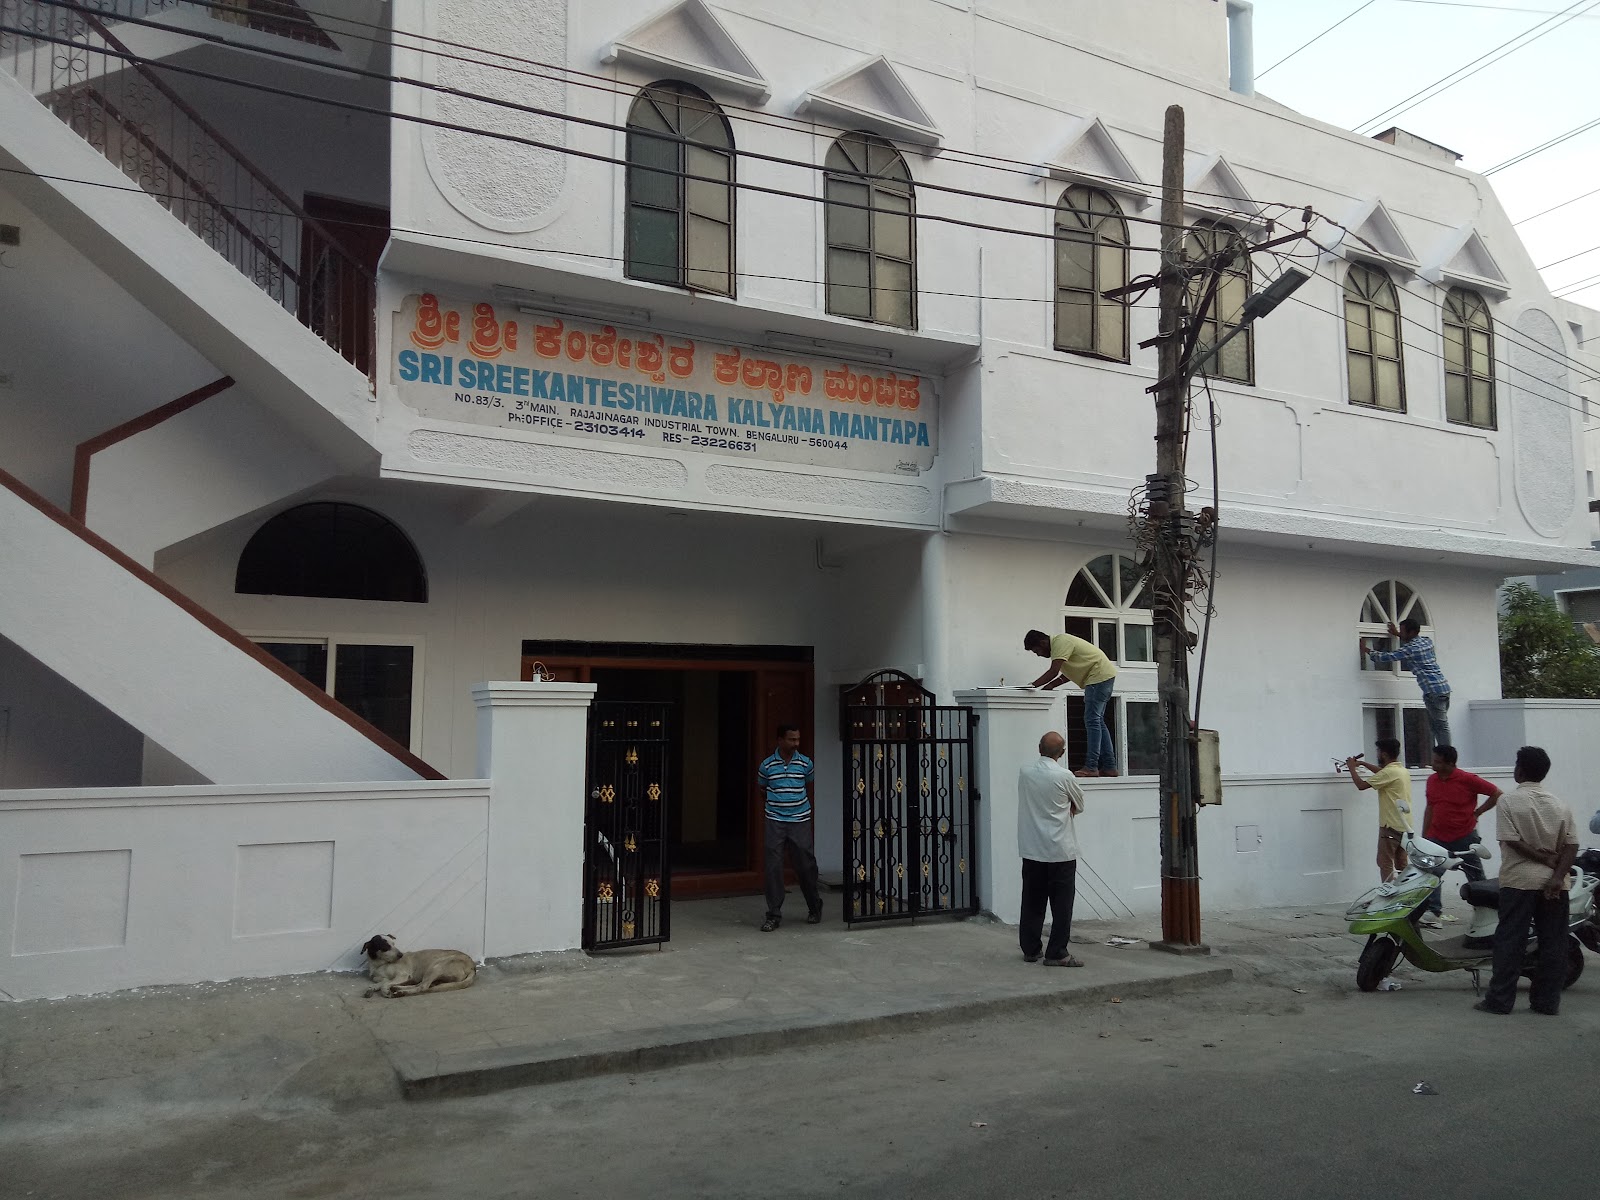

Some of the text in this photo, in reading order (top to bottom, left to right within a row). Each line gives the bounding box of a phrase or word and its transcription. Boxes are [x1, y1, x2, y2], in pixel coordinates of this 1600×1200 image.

[398, 349, 453, 386] SRI
[728, 397, 826, 434] KALYANA
[829, 410, 929, 447] MANTAPA
[409, 293, 921, 412] ಶ್ರೀ ಶ್ರೀ ಕಂಠೇಶ್ವರ ಕಲ್ಯಾಣ ಮಂಟಪ
[570, 408, 639, 425] RAJAJINAGAR
[644, 417, 702, 433] INDUSTRIAL
